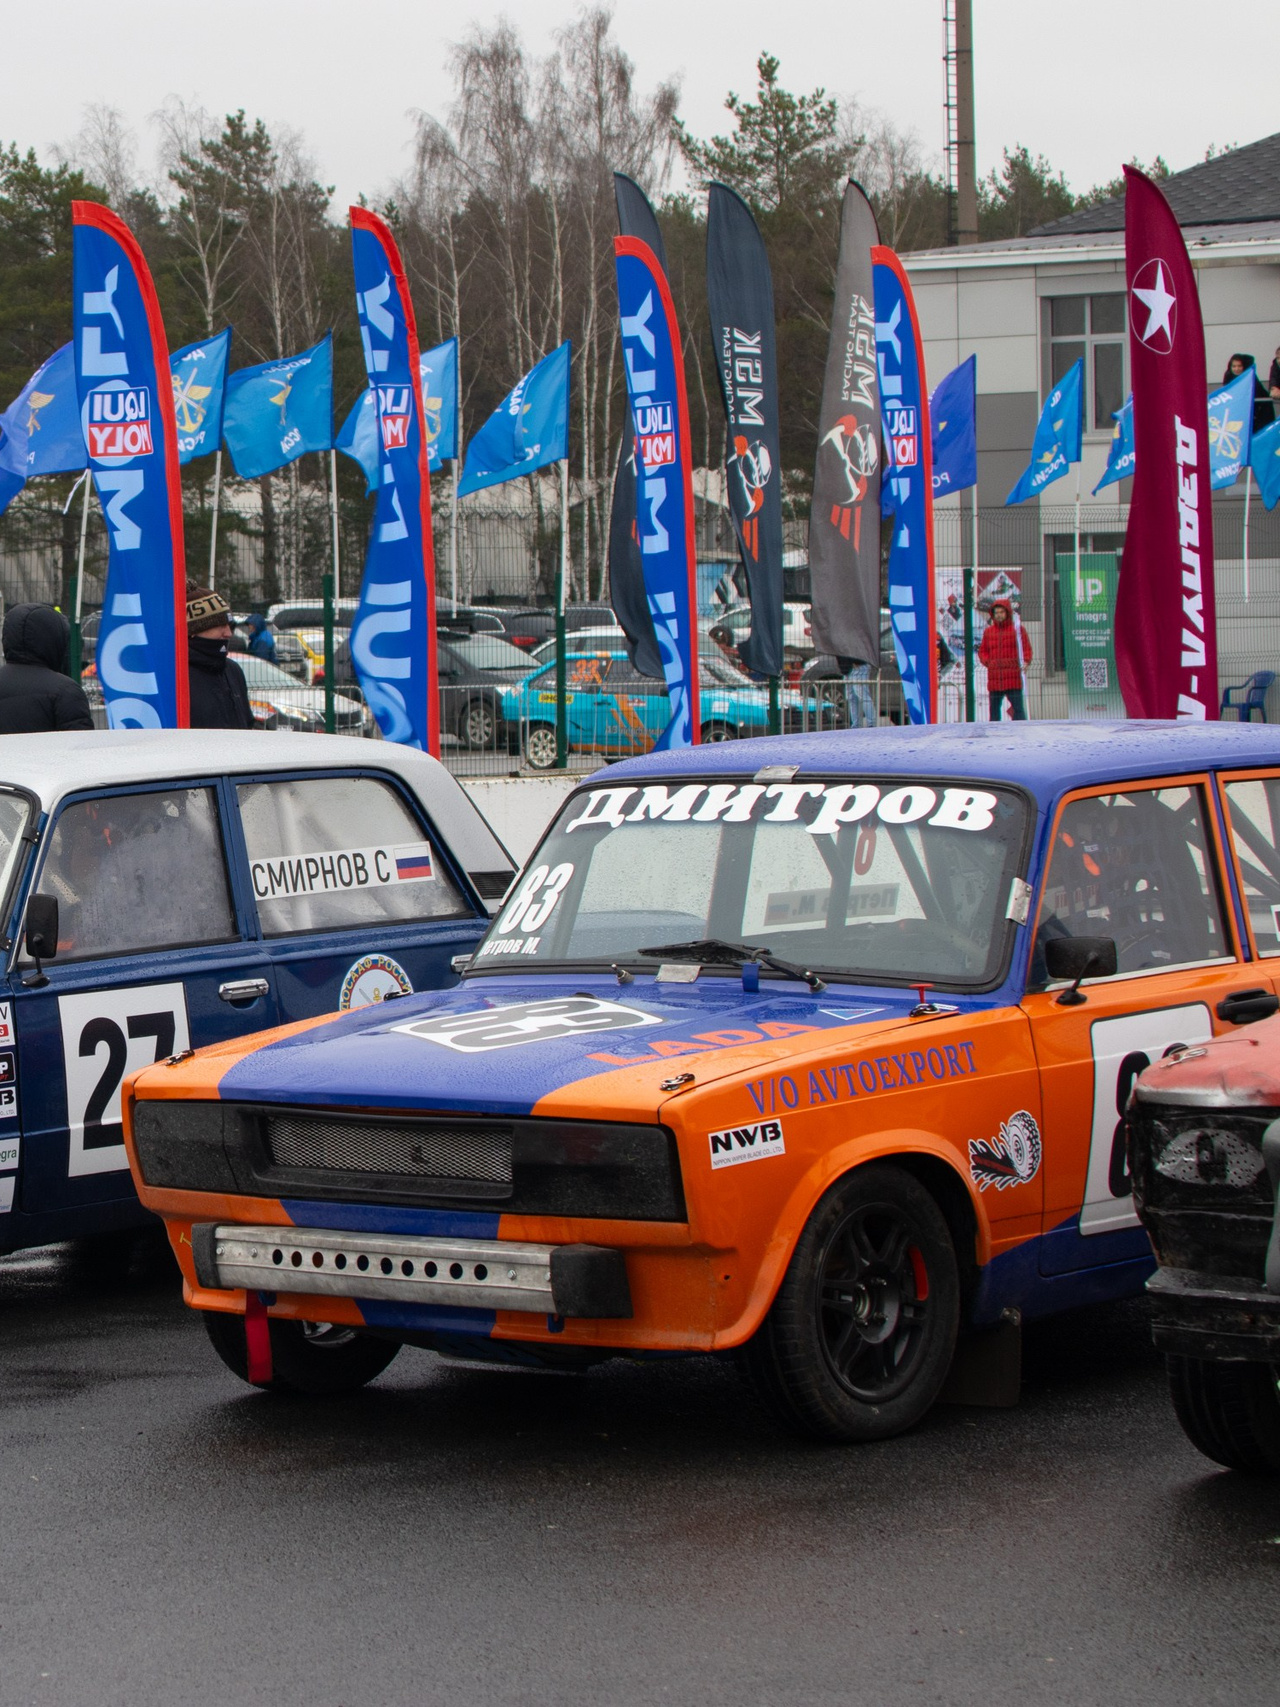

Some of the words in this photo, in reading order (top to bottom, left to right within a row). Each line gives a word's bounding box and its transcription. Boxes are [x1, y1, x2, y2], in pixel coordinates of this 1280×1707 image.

[252, 852, 369, 897] СМИРНОВ
[374, 849, 391, 883] С
[498, 862, 575, 934] 83
[340, 957, 373, 1011] ДОСААФ
[586, 1021, 826, 1067] LADA
[78, 1010, 176, 1151] 27
[745, 1075, 800, 1115] V/O
[808, 1041, 978, 1105] AVTOEXPORT
[710, 1122, 782, 1154] NWB
[713, 1158, 732, 1166] NIPPON
[732, 1154, 747, 1163] WIPER
[747, 1151, 762, 1159] BLADE
